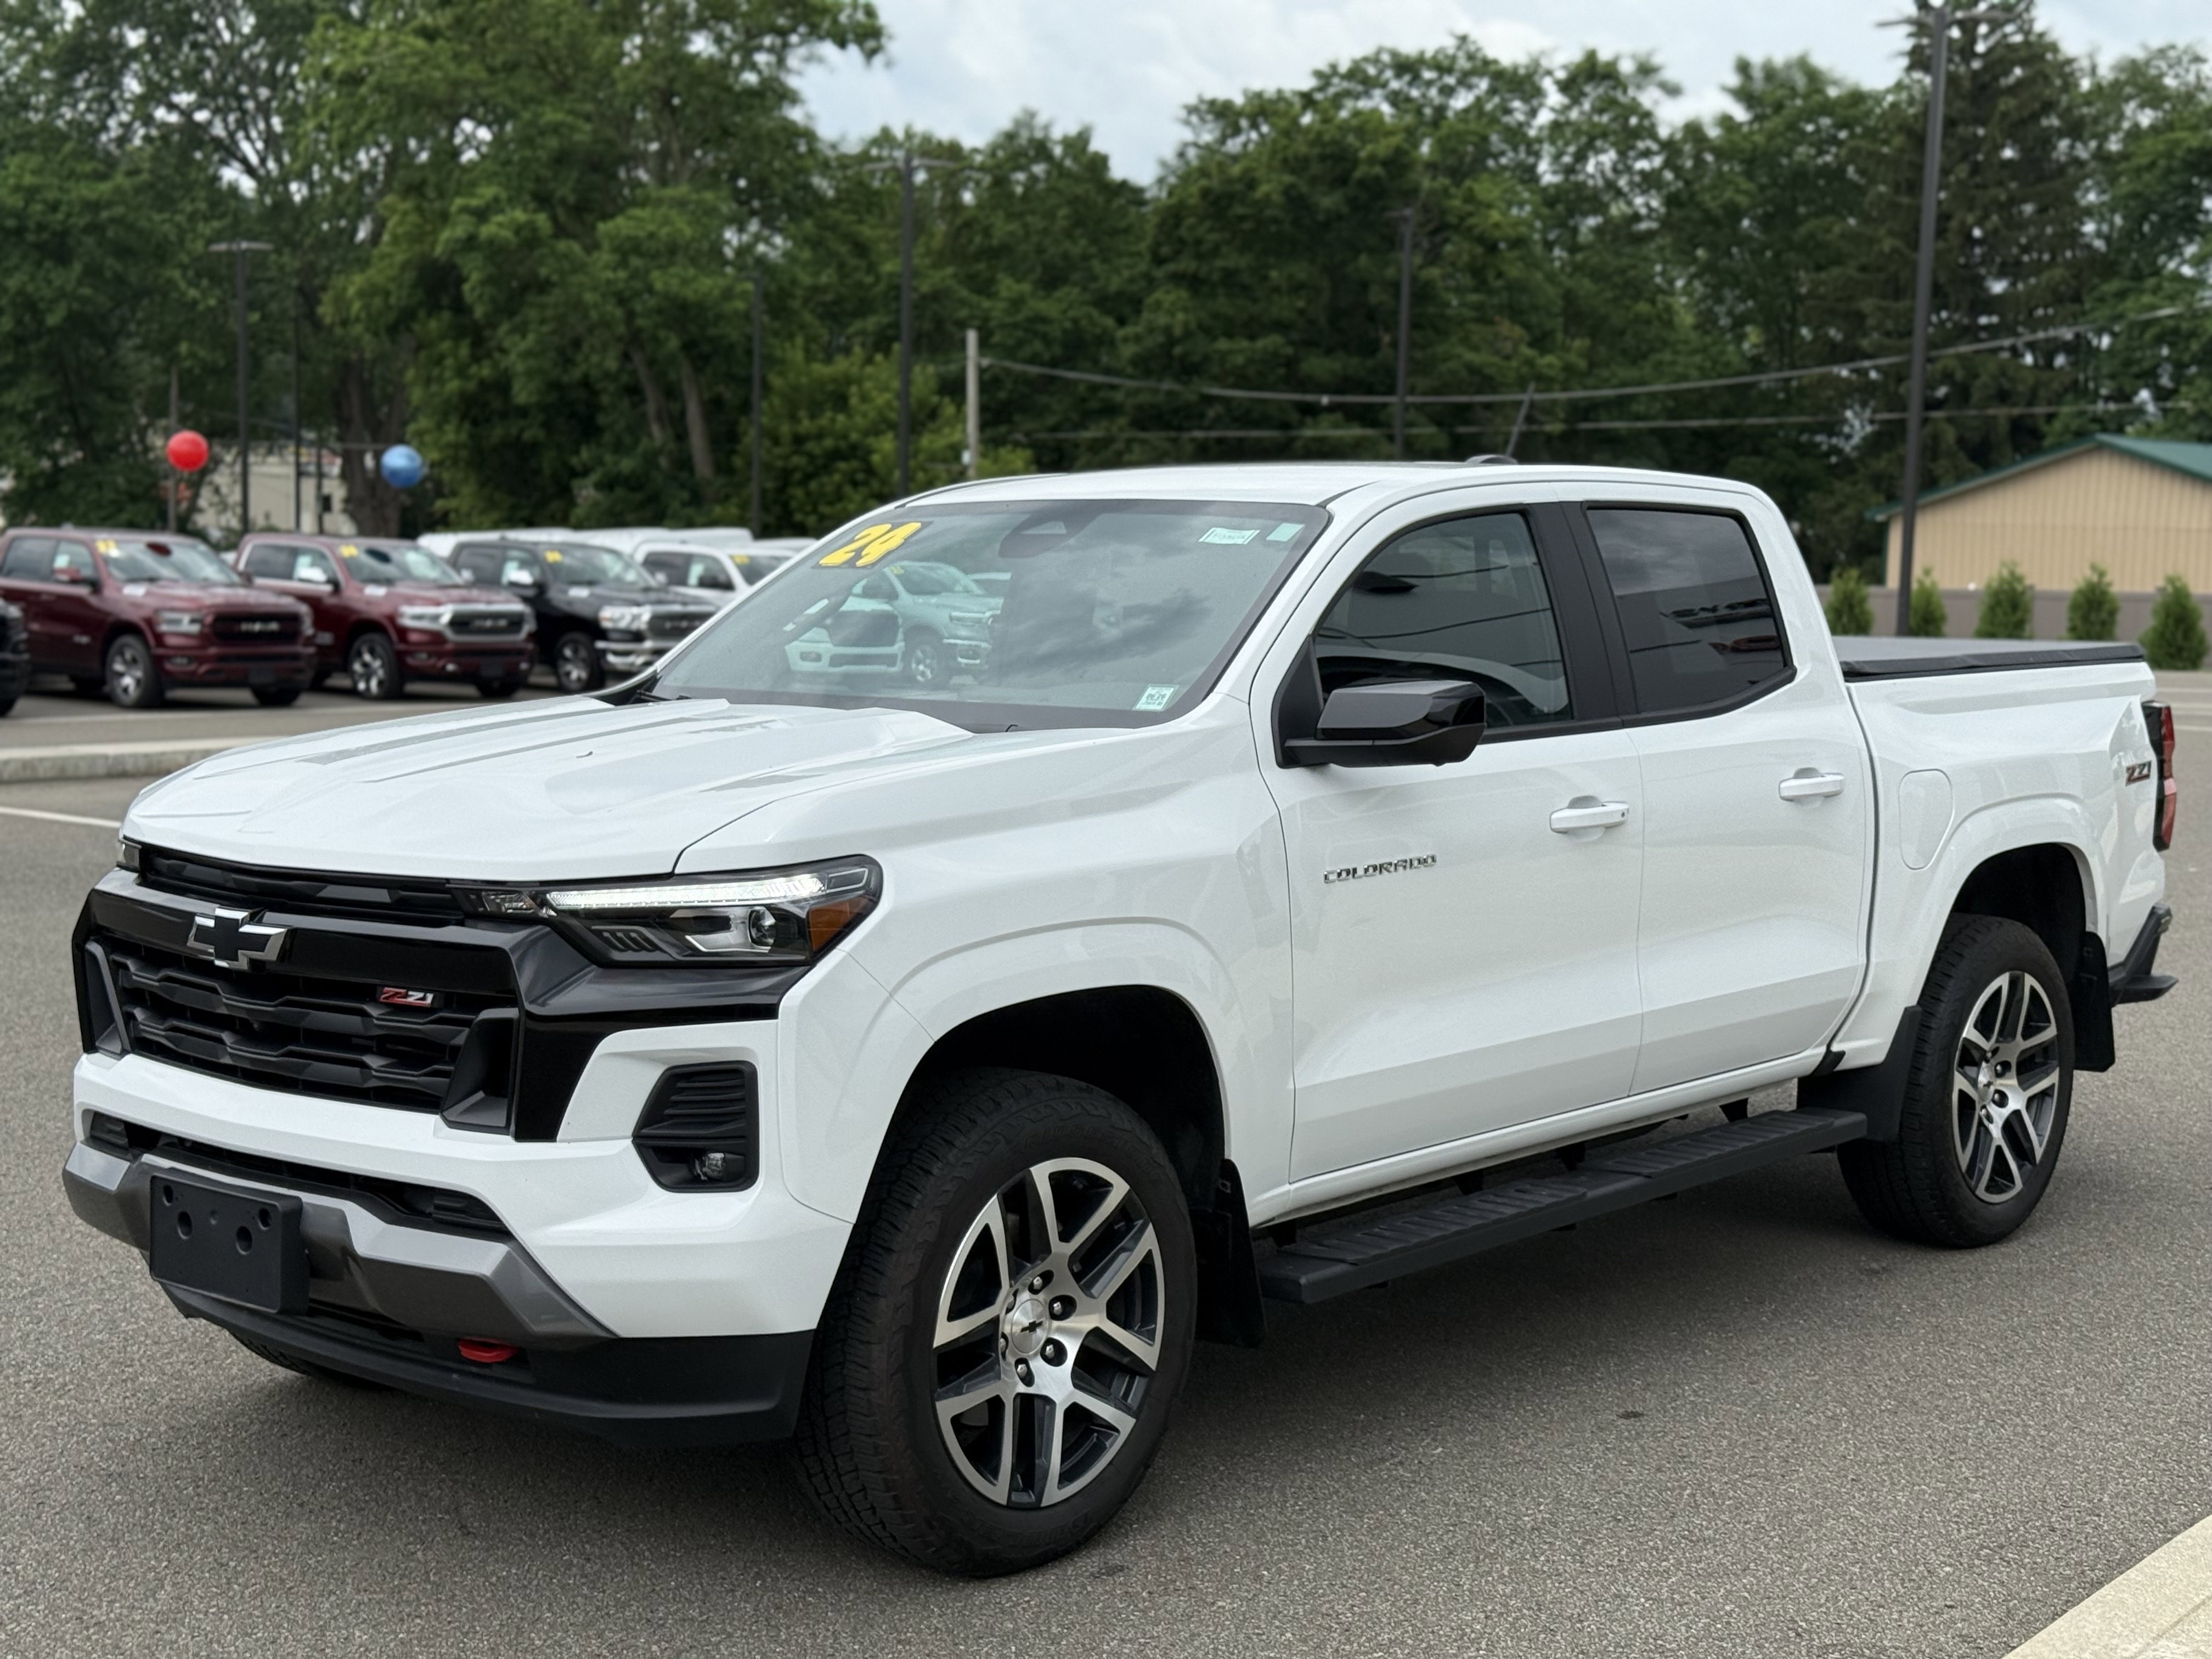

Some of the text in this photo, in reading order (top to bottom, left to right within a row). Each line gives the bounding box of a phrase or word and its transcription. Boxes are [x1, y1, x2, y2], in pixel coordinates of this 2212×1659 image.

[818, 521, 922, 568] 24
[2125, 760, 2152, 787] Z71
[1323, 854, 1437, 884] COLORADO
[380, 986, 435, 1008] Z71
